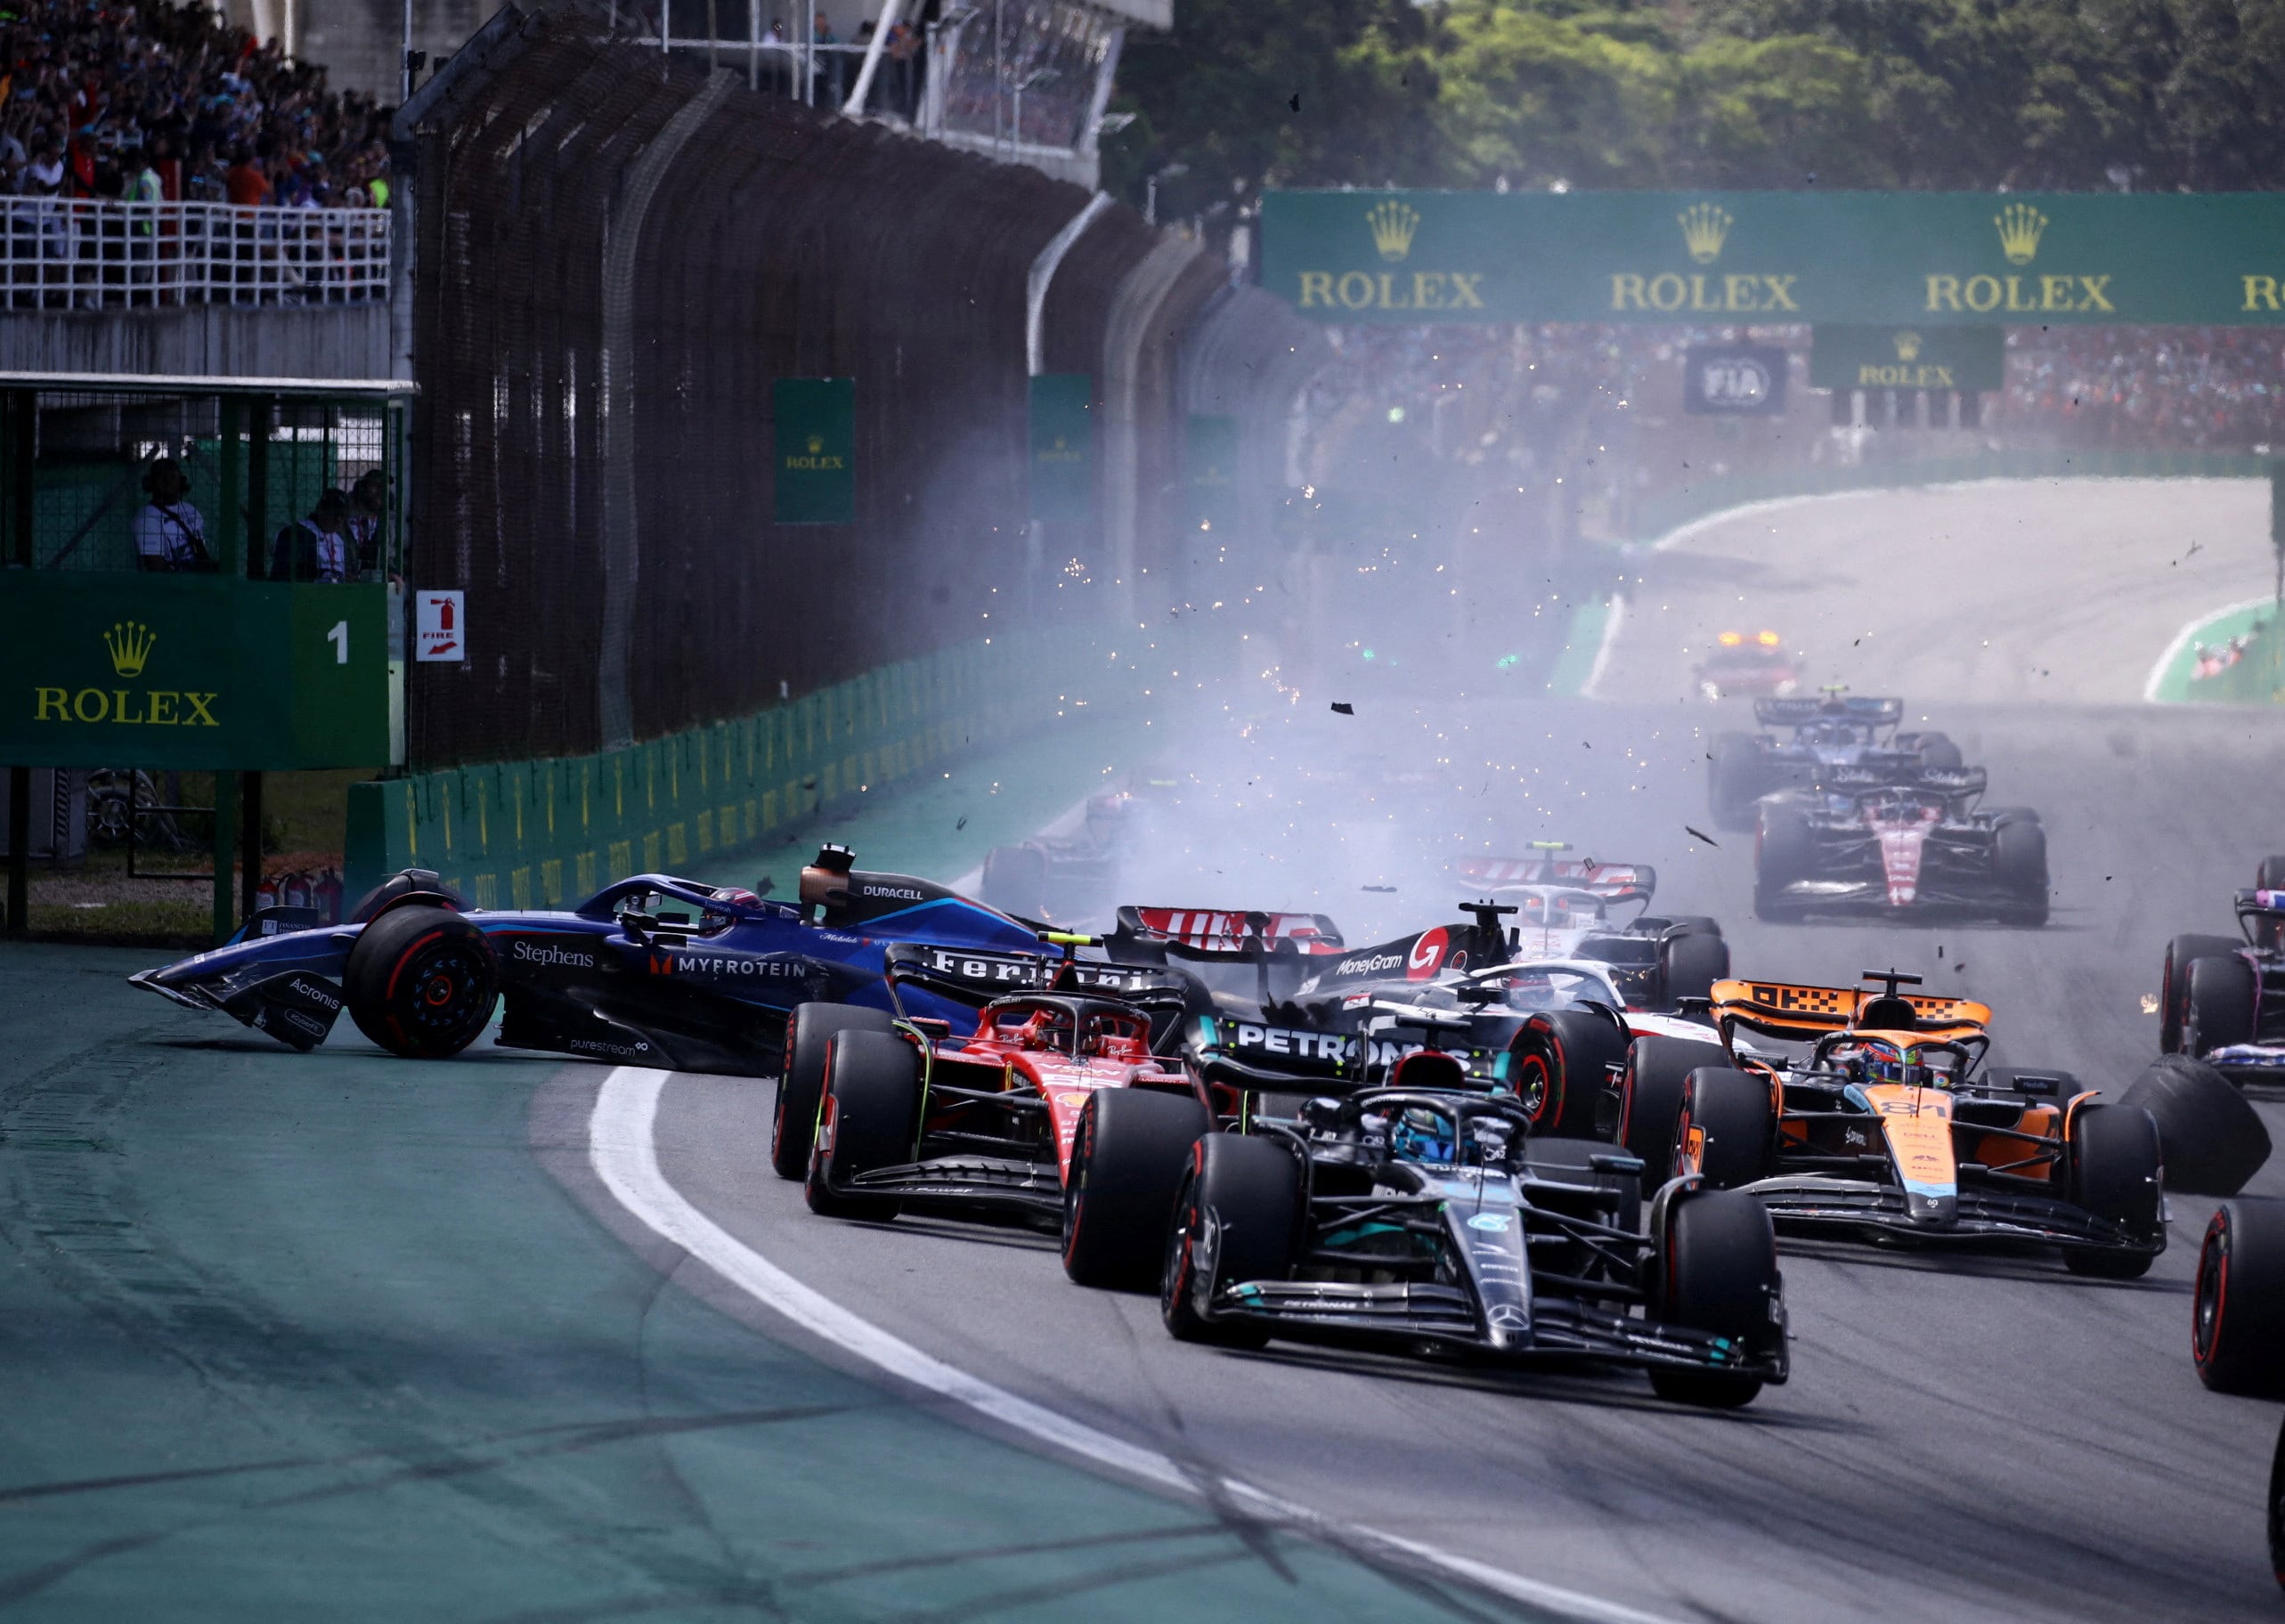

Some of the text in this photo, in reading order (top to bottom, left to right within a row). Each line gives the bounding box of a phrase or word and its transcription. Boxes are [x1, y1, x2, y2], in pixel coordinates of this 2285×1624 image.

[1298, 272, 1484, 310] ROLEX
[1611, 272, 1800, 312] ROLEX
[1924, 274, 2116, 313] ROLEX
[2241, 275, 2285, 311] R
[1703, 367, 1761, 399] FIA
[1858, 365, 1954, 386] ROLEX
[785, 455, 843, 470] ROLEX
[327, 621, 348, 664] 1
[34, 687, 220, 727] ROLEX
[863, 885, 923, 900] DURACELL
[514, 940, 594, 968] Stephens
[679, 957, 806, 978] MYPROTEIN
[1336, 954, 1403, 976] MoneyGram
[289, 978, 339, 1010] Acronis
[571, 1039, 636, 1057] purestream
[1239, 1024, 1471, 1072] PETRONS
[1880, 1101, 1947, 1118] 81
